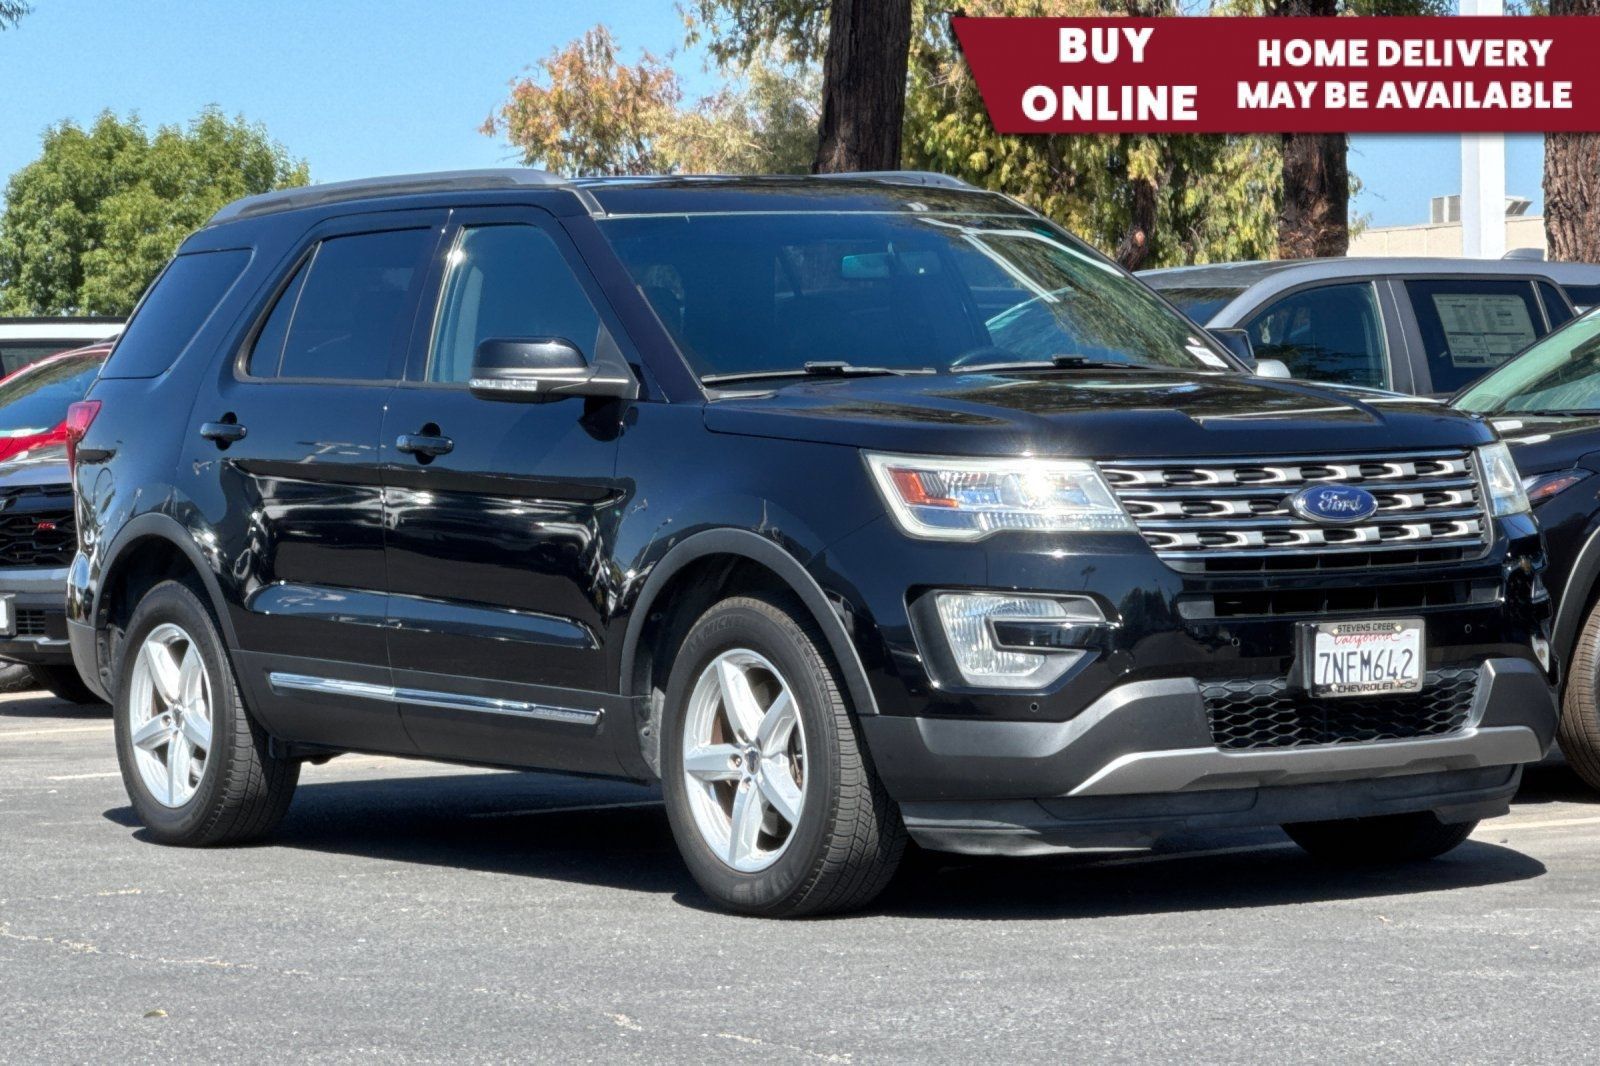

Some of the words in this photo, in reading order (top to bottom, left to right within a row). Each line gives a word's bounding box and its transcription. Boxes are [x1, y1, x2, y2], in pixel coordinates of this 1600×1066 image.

[1318, 490, 1362, 513] Ford
[38, 522, 56, 530] RS
[1337, 623, 1371, 633] STEVENS
[1372, 622, 1396, 631] CREEK
[1319, 648, 1414, 684] 7NFM642
[1337, 683, 1394, 693] CHEVROLET
